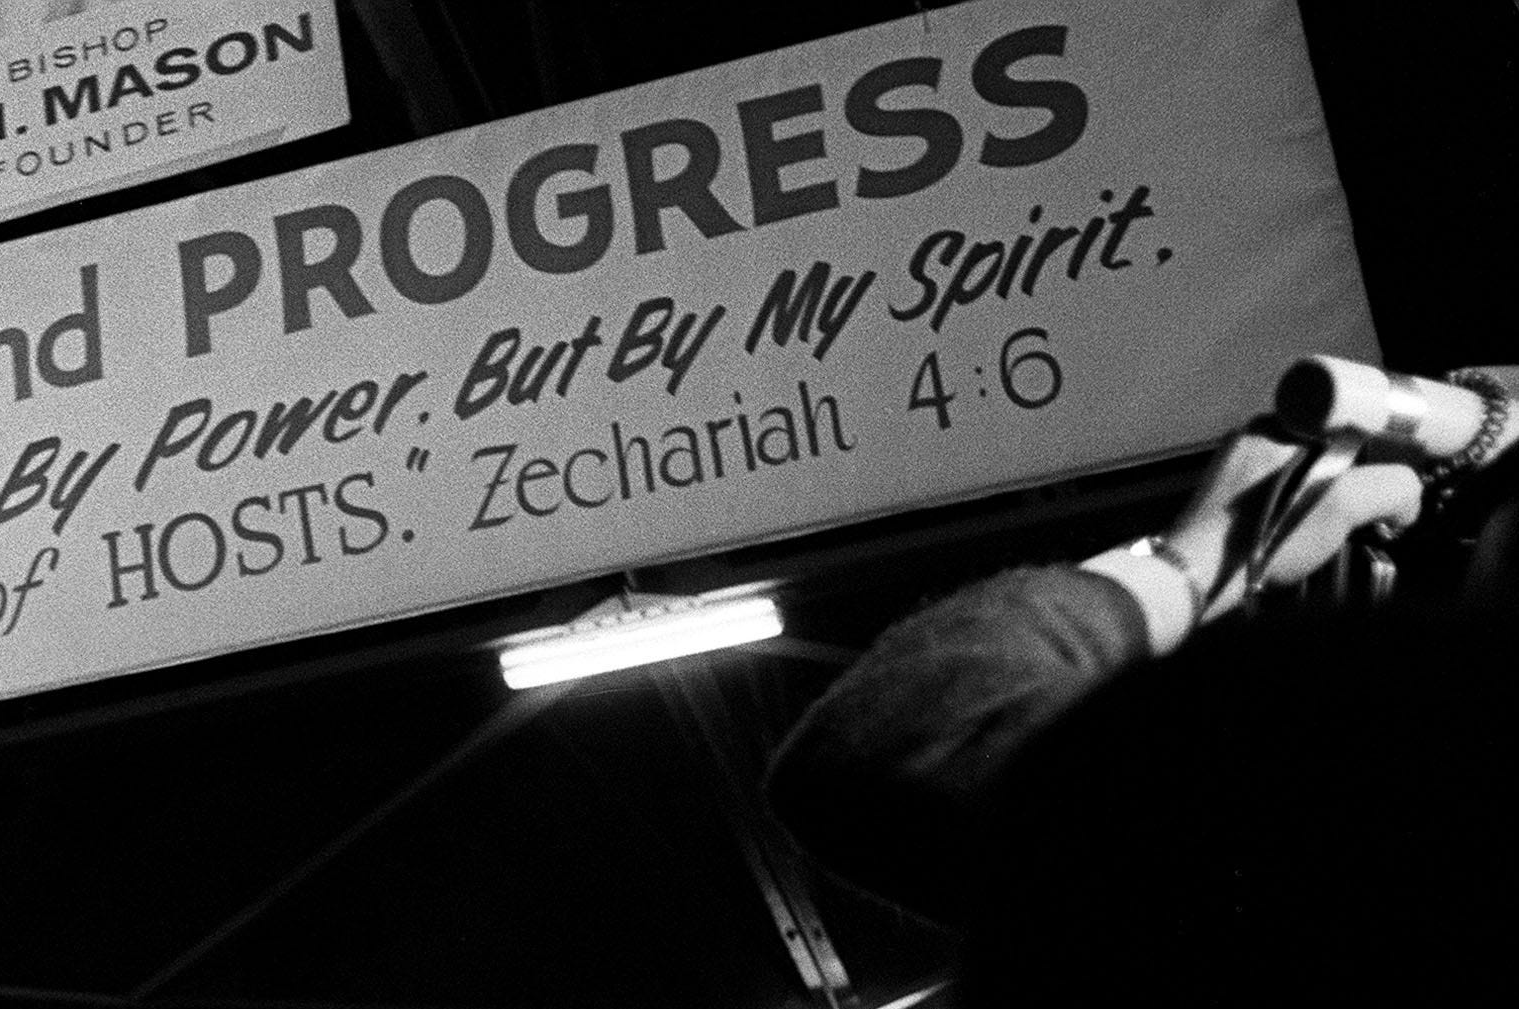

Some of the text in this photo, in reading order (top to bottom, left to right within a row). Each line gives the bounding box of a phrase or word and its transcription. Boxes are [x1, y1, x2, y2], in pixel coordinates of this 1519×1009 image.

[8, 18, 169, 82] BISHOP
[43, 13, 314, 126] MASON
[178, 25, 1089, 359] PROGRESS
[135, 371, 430, 492] Power.
[454, 316, 602, 420] But
[607, 297, 726, 395] By
[745, 261, 876, 361] My
[890, 186, 1173, 330] Spirit.
[469, 380, 857, 532] Zechariah
[909, 327, 1064, 430] 4:6
